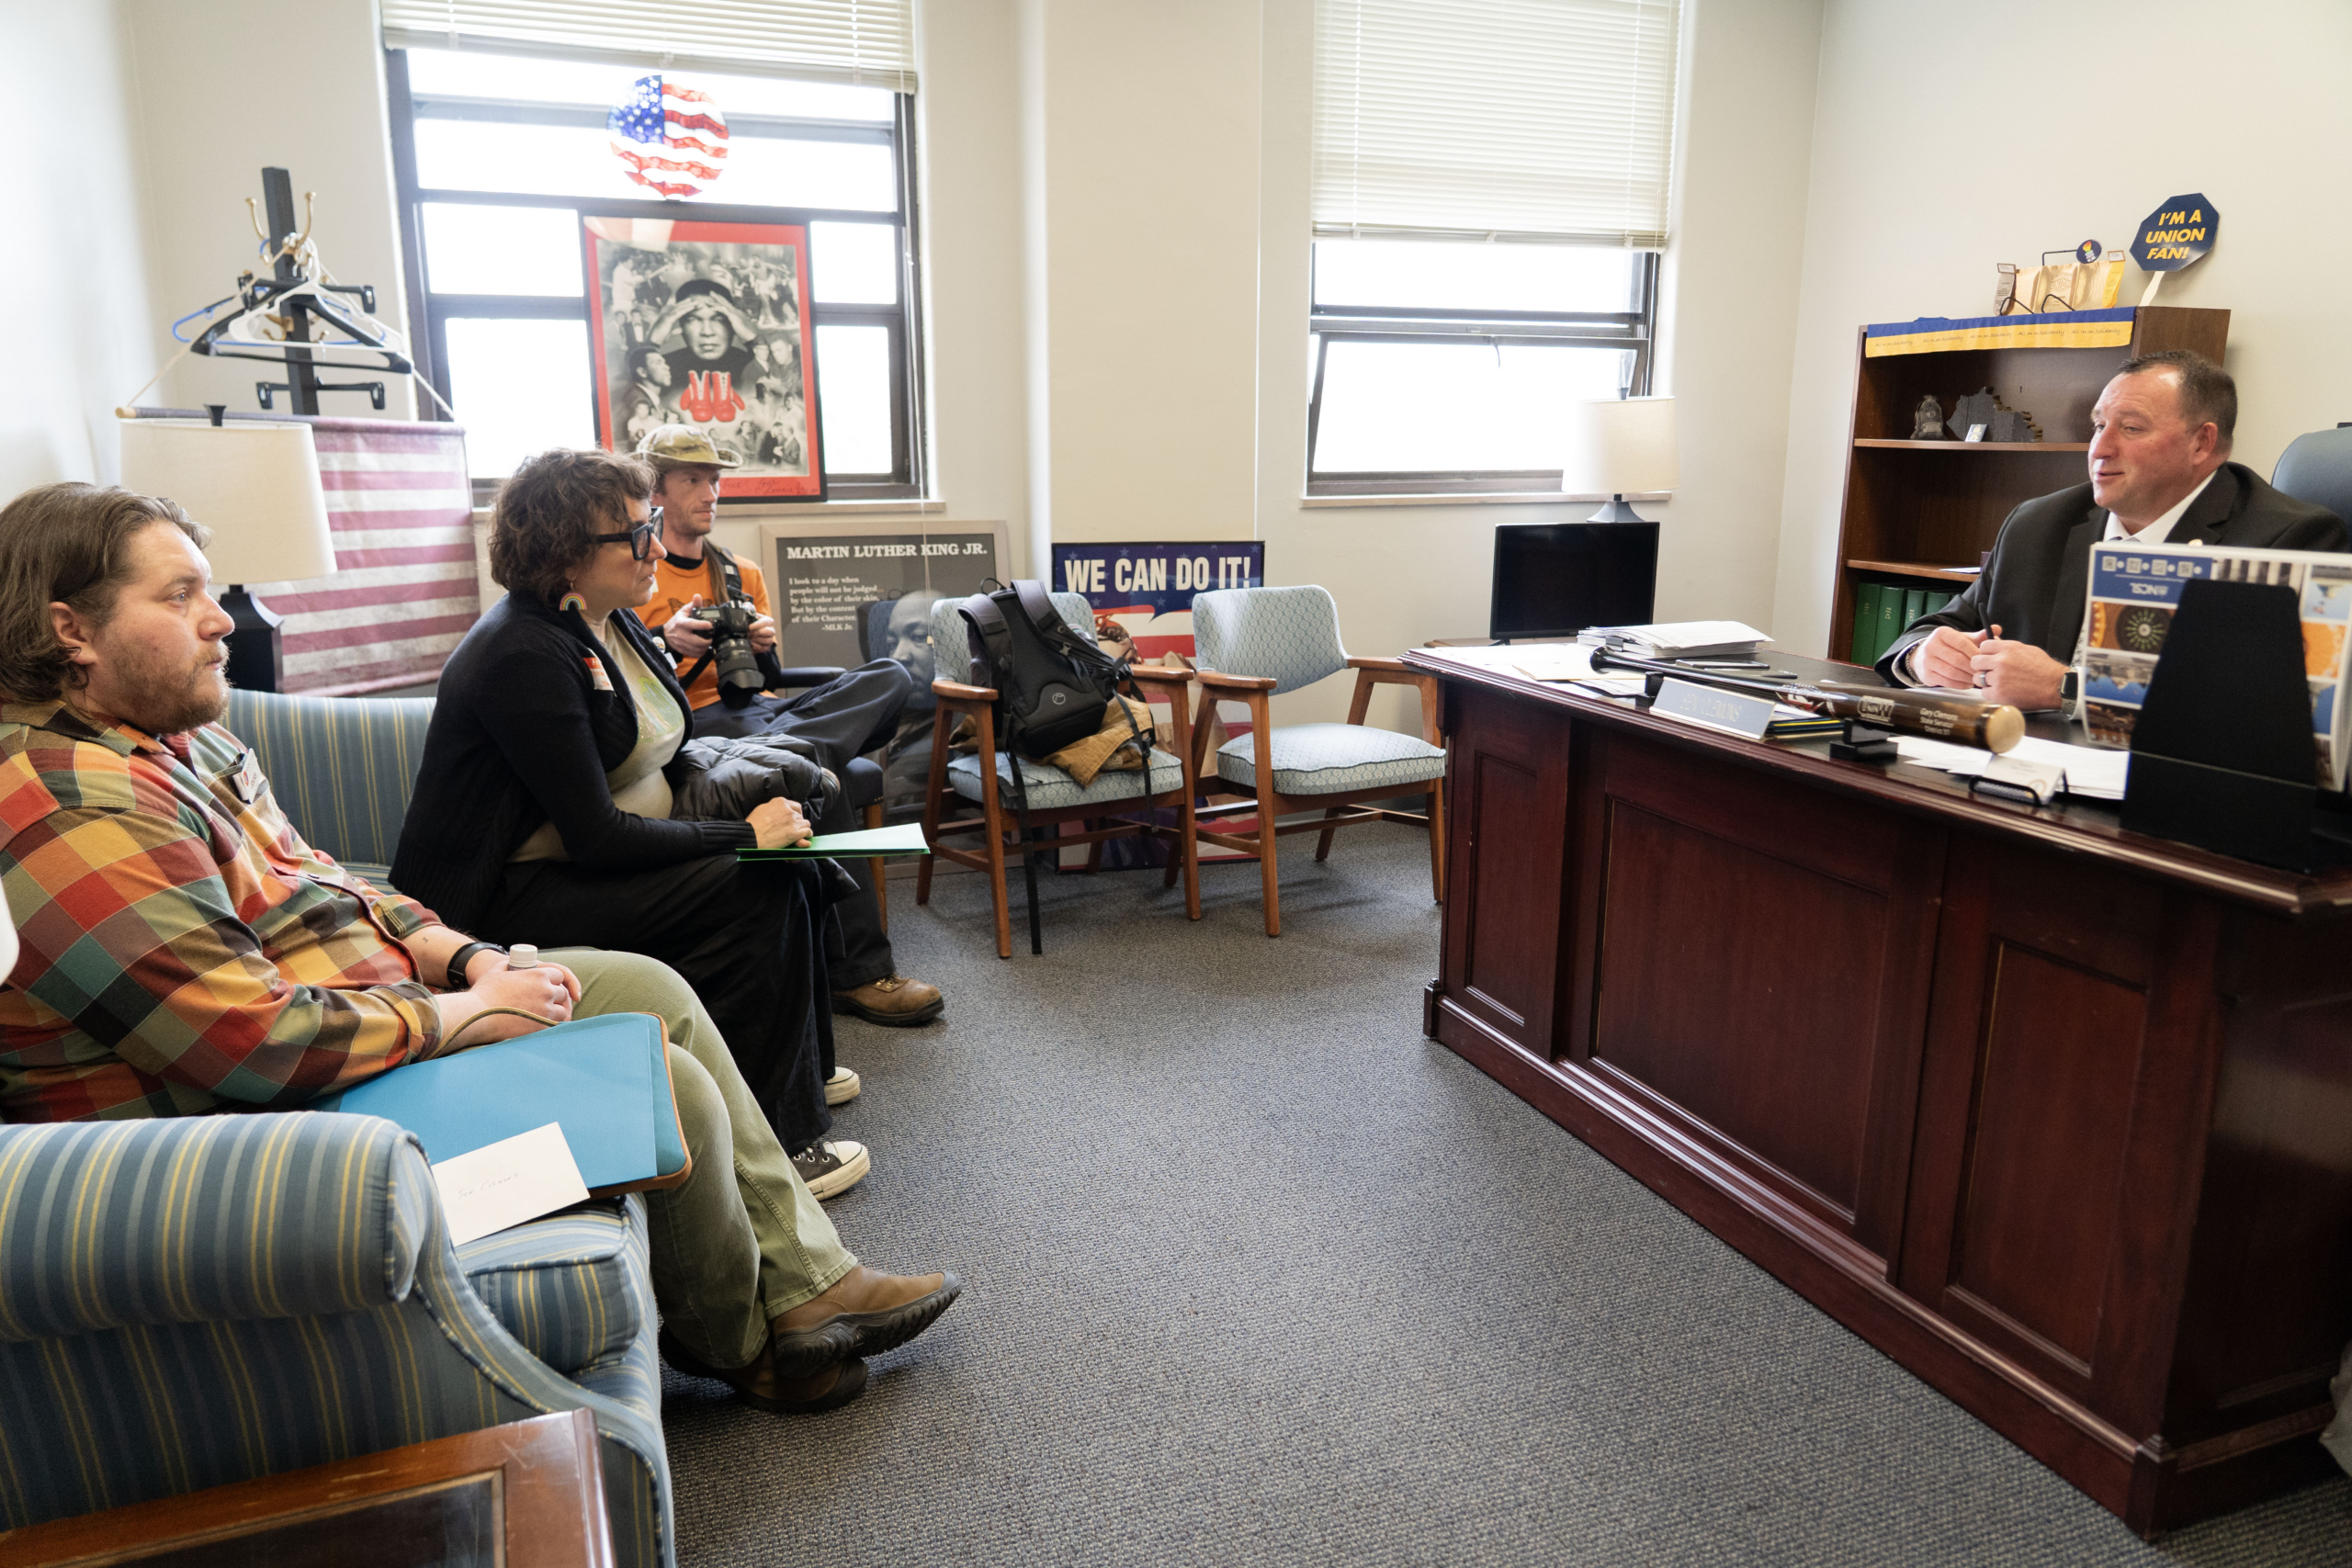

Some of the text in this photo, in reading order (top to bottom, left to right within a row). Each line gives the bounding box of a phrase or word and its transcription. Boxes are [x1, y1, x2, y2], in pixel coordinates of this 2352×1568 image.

[2158, 209, 2201, 226] I'M A
[2145, 228, 2206, 243] UNION
[2146, 247, 2190, 259] FAN!
[787, 543, 988, 558] MARTIN LUTHER KING JR.
[1065, 557, 1250, 592] WE CAN DO IT!
[827, 577, 839, 585] day
[789, 588, 813, 596] people
[853, 585, 877, 593] judged
[790, 597, 798, 605] by
[806, 606, 814, 615] by
[1920, 708, 1958, 721] Gary Clemons
[1920, 716, 1954, 728] State Senator
